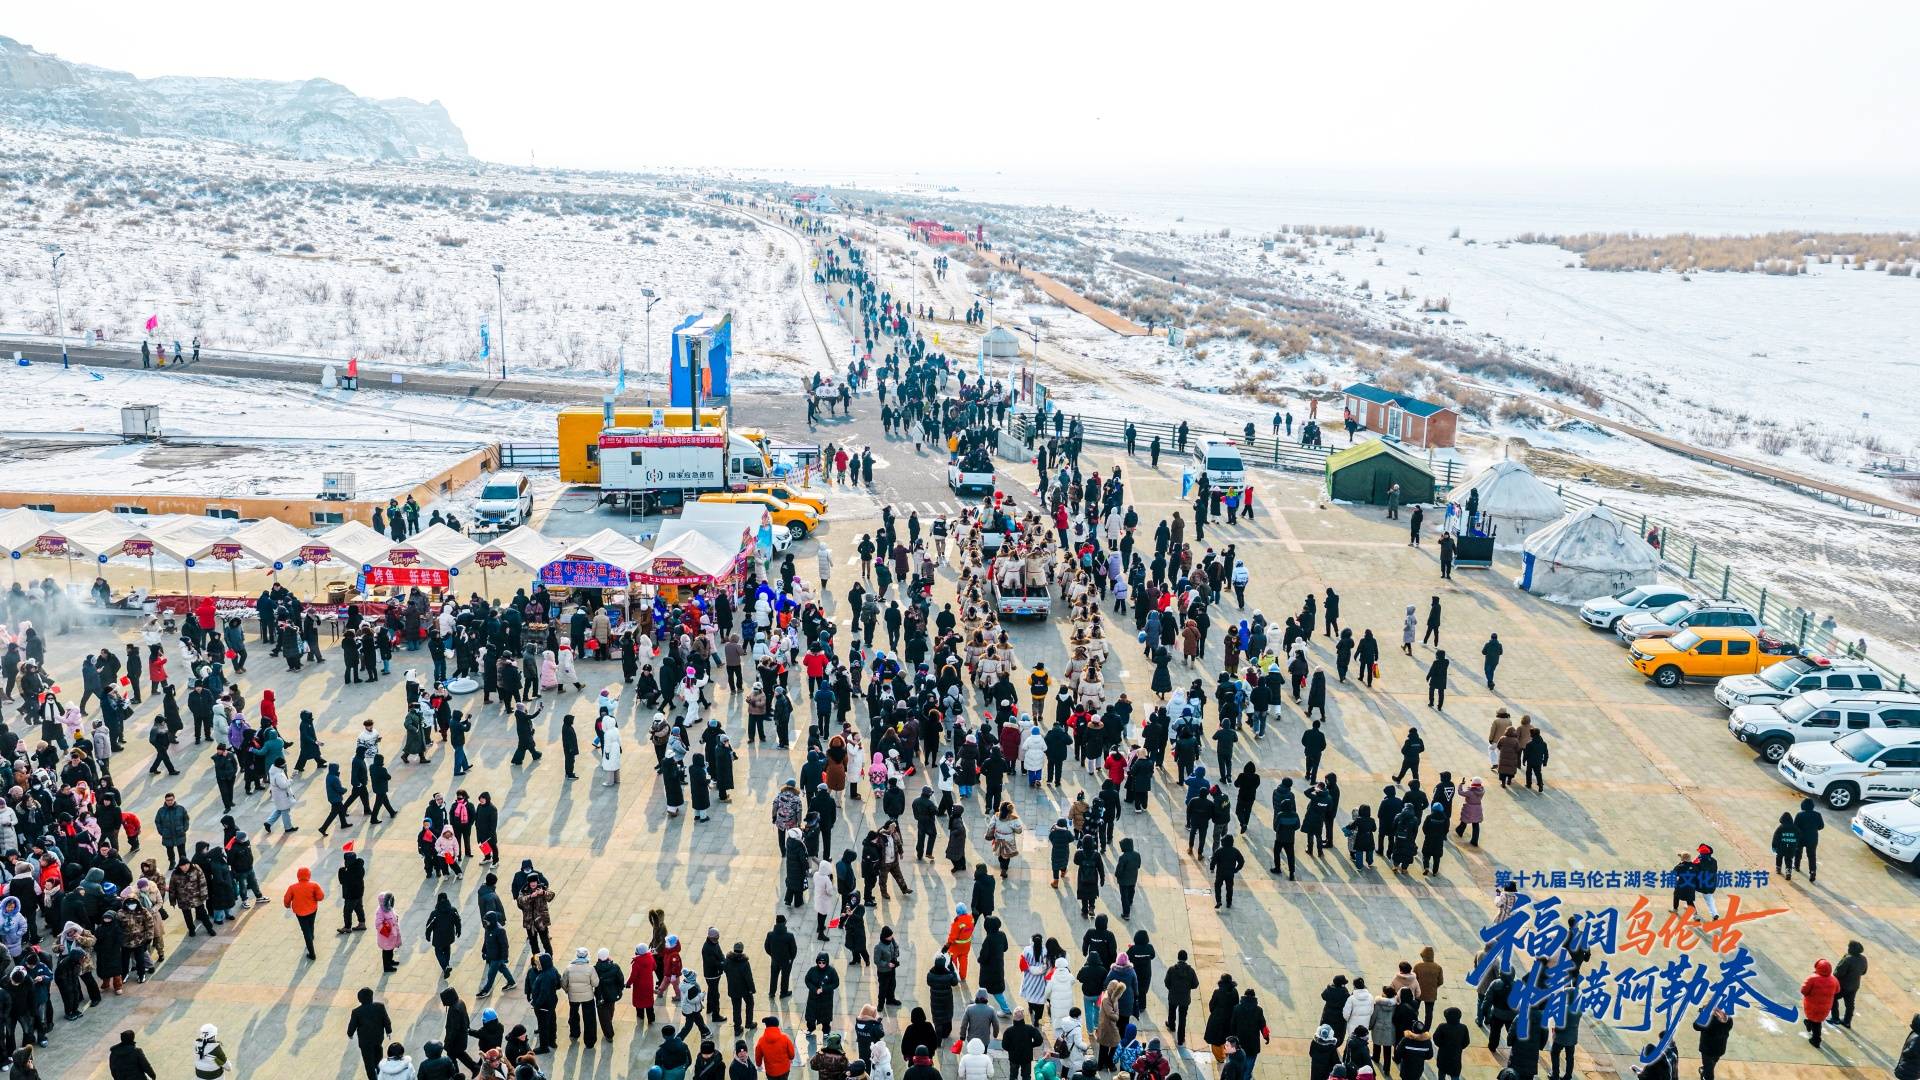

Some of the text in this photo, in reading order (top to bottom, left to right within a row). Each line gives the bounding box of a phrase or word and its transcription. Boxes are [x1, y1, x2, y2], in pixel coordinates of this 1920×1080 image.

[668, 471, 714, 479] 国家应急通信
[373, 568, 395, 583] 烤鱼
[409, 570, 443, 585] 新鲜鱼
